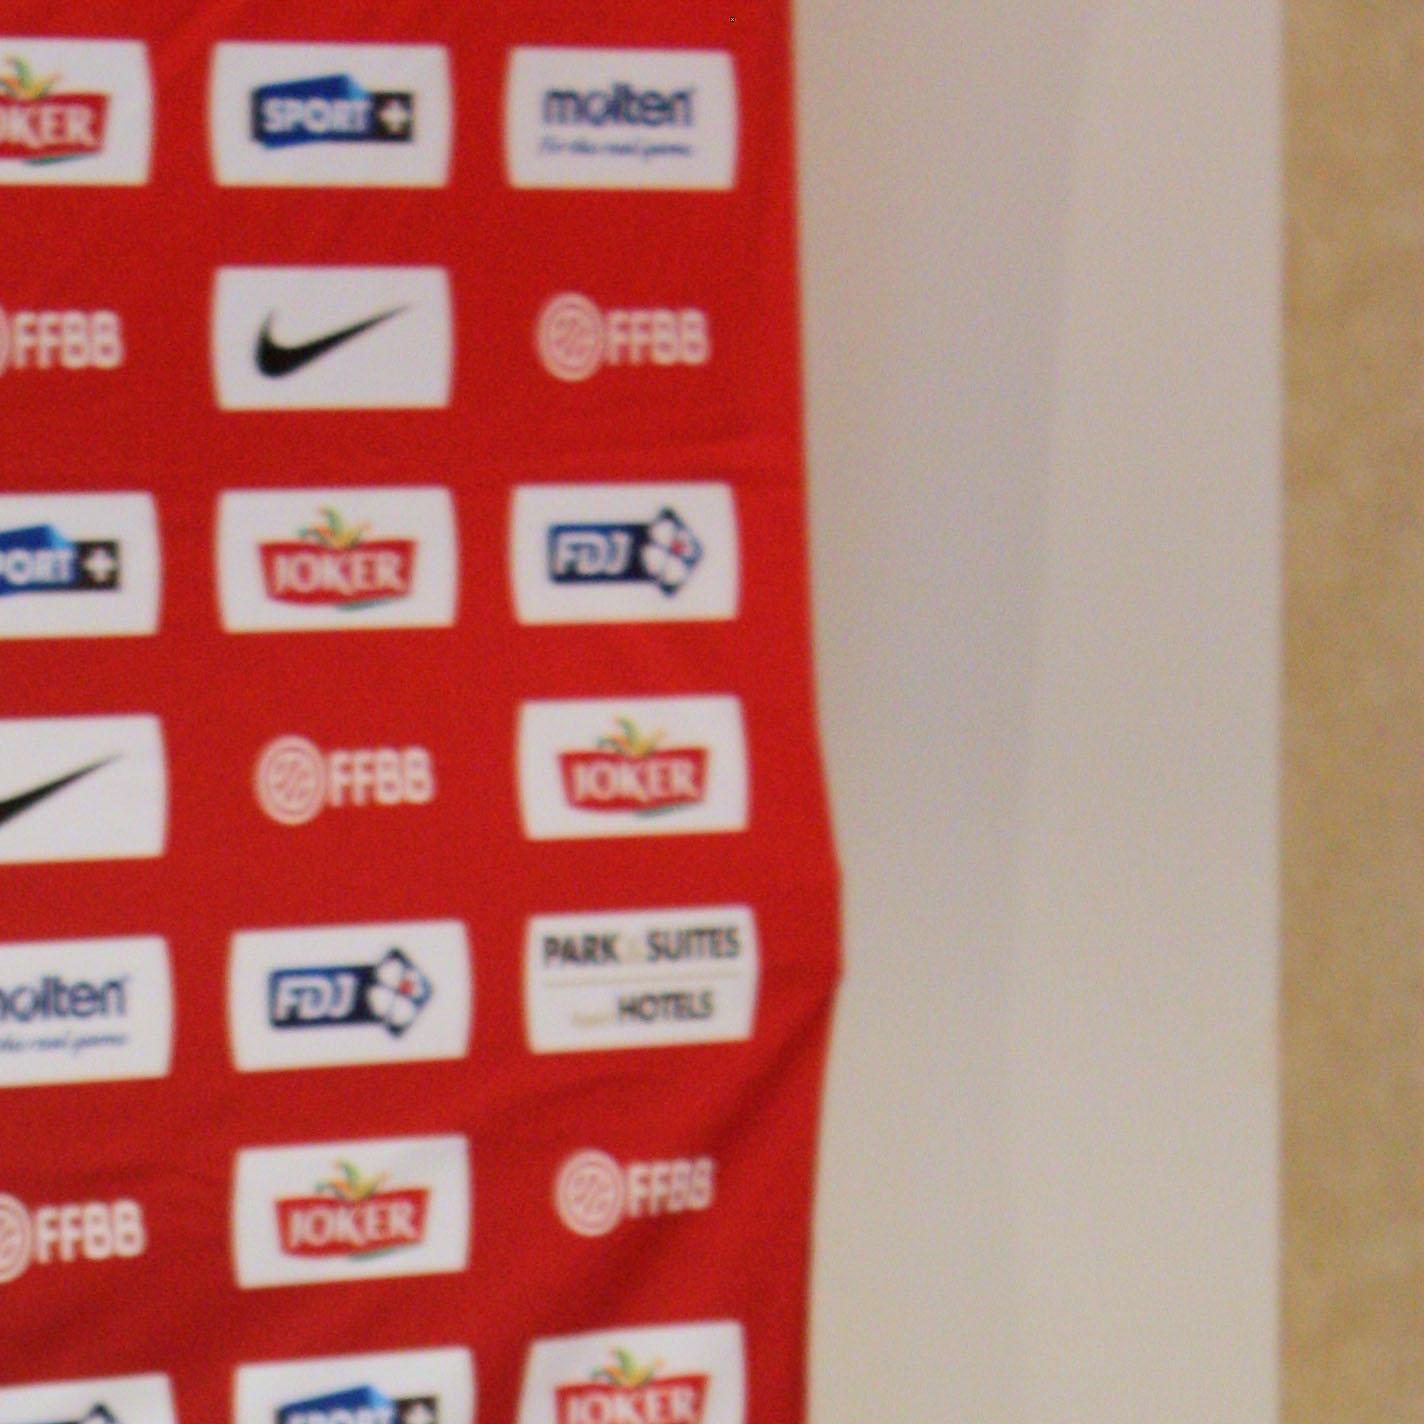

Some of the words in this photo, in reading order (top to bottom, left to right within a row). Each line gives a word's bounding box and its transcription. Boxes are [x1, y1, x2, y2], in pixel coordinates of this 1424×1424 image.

[542, 82, 694, 126] molten
[10, 309, 124, 370] FFBB
[604, 307, 711, 366] FFBB
[274, 547, 411, 596] JOKER
[553, 530, 633, 577] FDJ
[327, 746, 436, 807] FFBB
[570, 756, 702, 803] JOKER
[543, 935, 619, 966] PARK
[646, 926, 741, 961] SUITES
[274, 976, 356, 1023] FDJ
[618, 991, 714, 1022] HOTELS
[626, 1157, 718, 1219] FFBB
[32, 1200, 147, 1264] FFBB
[288, 1199, 423, 1248] JOKER
